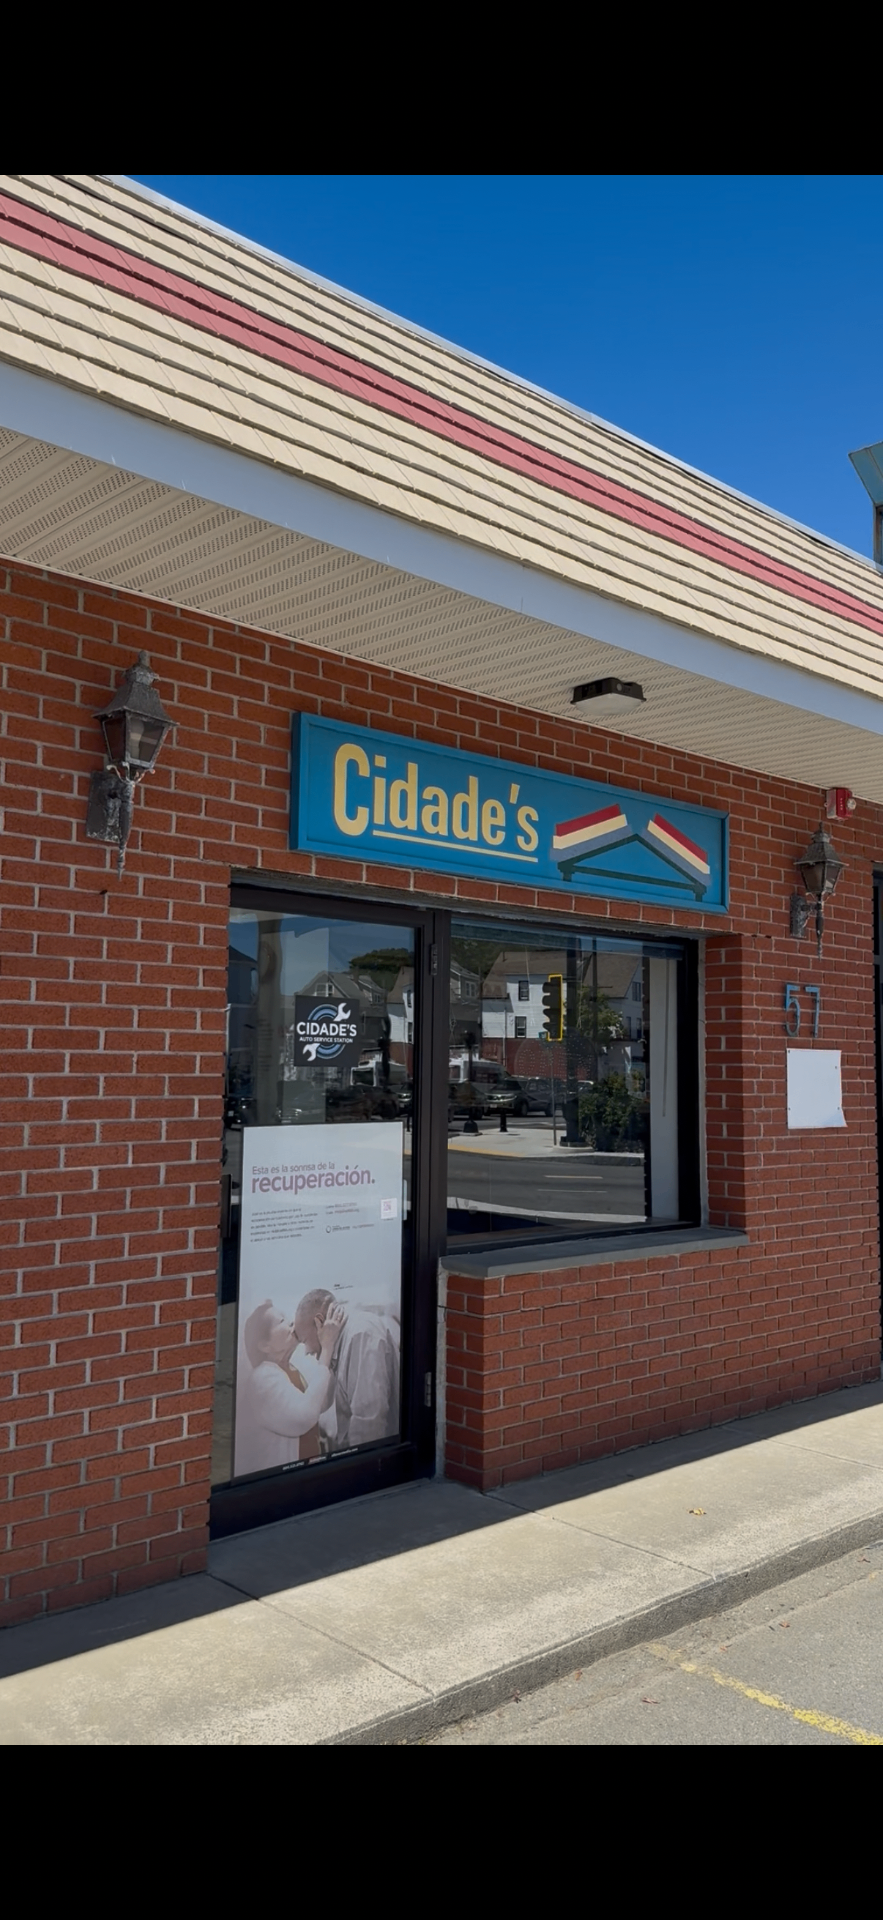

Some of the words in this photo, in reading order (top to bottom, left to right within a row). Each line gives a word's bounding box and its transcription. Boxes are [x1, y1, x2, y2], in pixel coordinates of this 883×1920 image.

[334, 743, 539, 852] Cidade's
[785, 983, 820, 1038] 57
[297, 1022, 357, 1036] CIDADE'S
[252, 1166, 269, 1175] Esta
[270, 1166, 280, 1174] es
[281, 1164, 289, 1173] la
[317, 1162, 327, 1170] de
[328, 1161, 335, 1170] la
[252, 1165, 375, 1195] recuperación.
